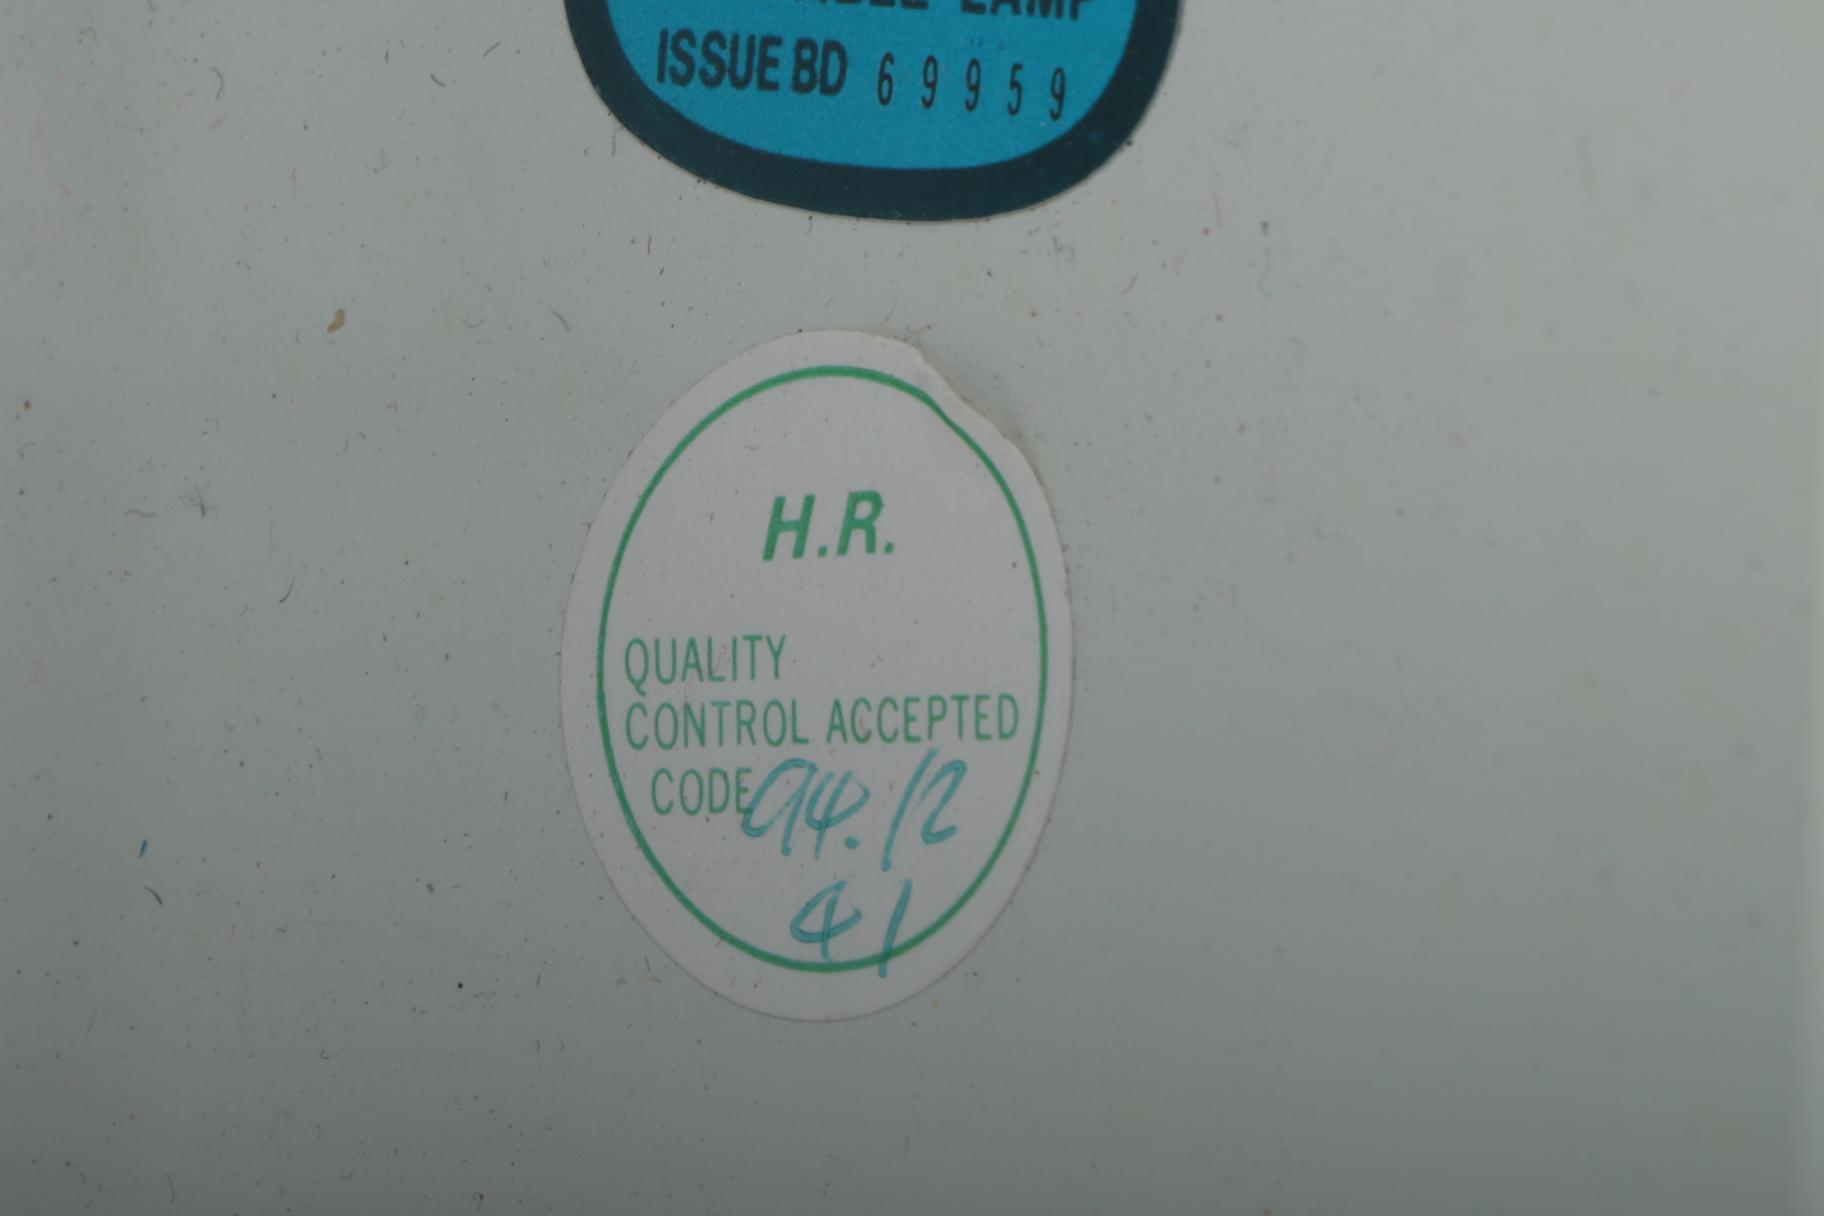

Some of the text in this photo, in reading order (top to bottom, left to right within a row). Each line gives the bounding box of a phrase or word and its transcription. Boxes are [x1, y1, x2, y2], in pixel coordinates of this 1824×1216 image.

[657, 28, 782, 92] ISSUE
[791, 37, 848, 97] BD
[763, 490, 895, 561] H.R.
[624, 634, 787, 695] QUALITY
[626, 693, 1019, 750] CONTROL ACCEPTED
[651, 767, 754, 816] CODE
